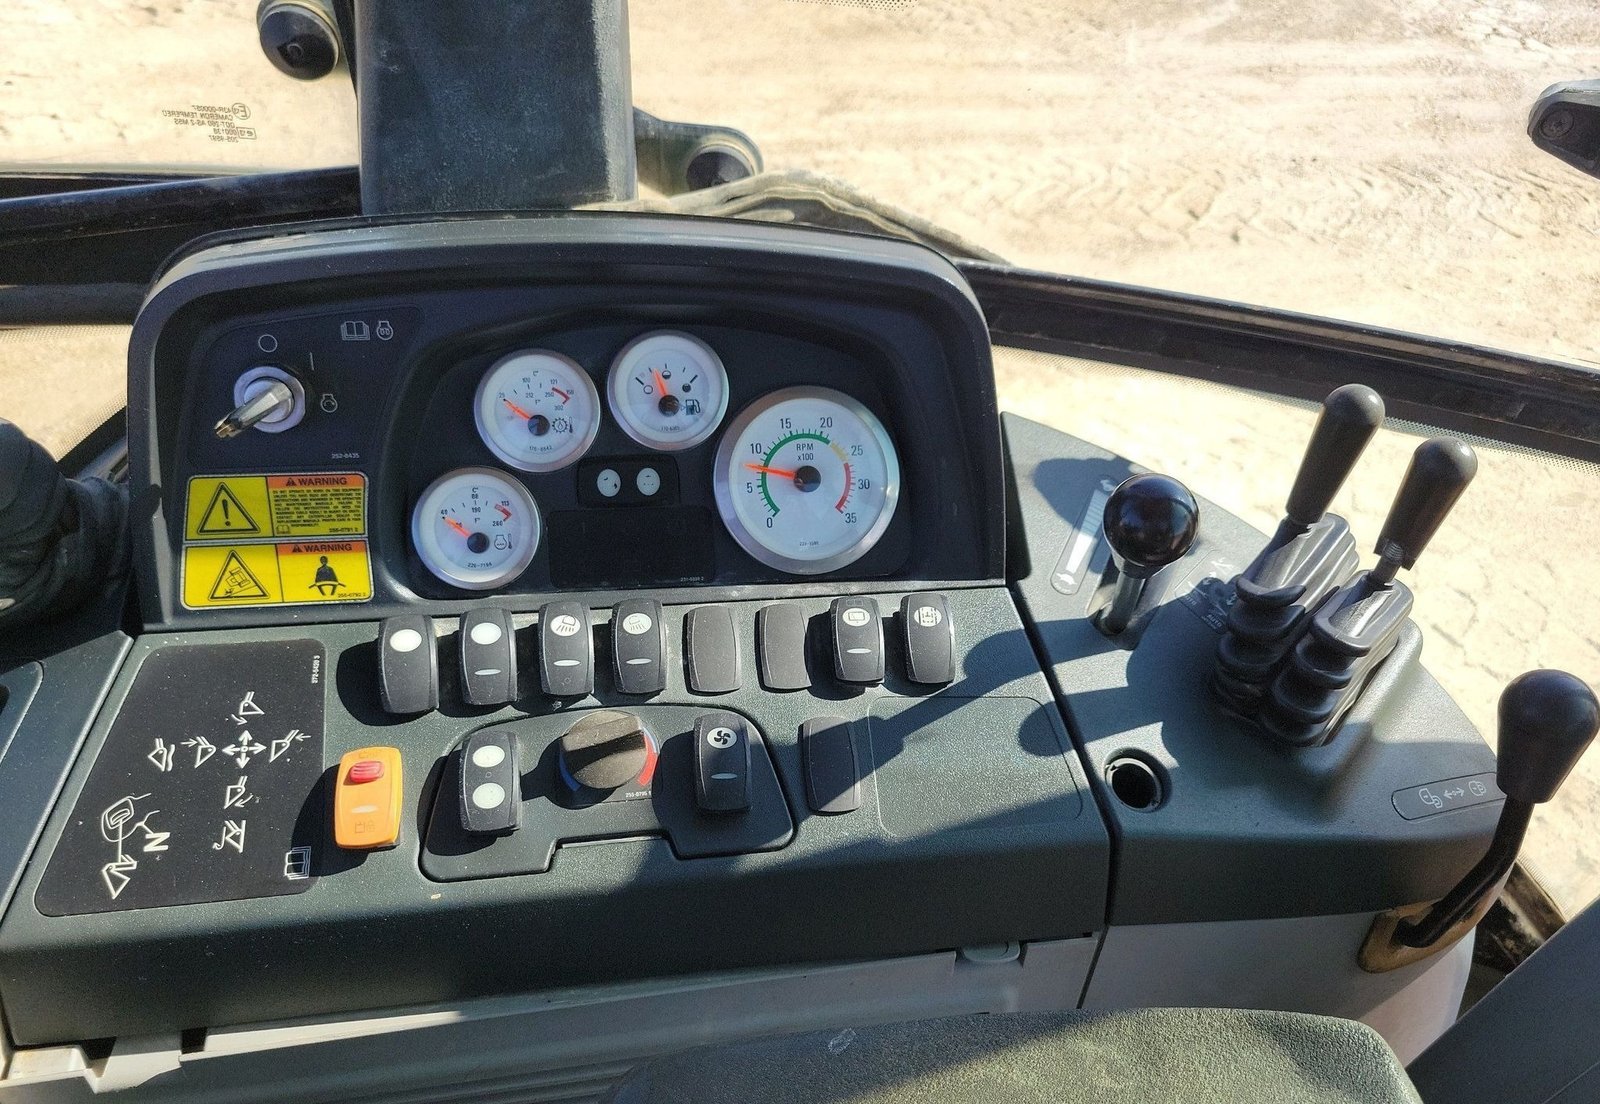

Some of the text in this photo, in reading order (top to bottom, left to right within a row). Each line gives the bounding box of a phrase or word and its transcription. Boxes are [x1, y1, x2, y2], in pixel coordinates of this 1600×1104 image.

[780, 418, 792, 429] 15
[820, 417, 833, 428] 20
[750, 443, 762, 455] 10
[796, 443, 814, 451] RPM
[851, 445, 863, 456] 25
[797, 453, 814, 461] x100
[298, 477, 347, 486] WARNING
[858, 478, 870, 489] 30
[746, 482, 753, 494] 5
[766, 517, 773, 528] 0
[845, 512, 857, 523] 35
[303, 543, 353, 553] WARNING
